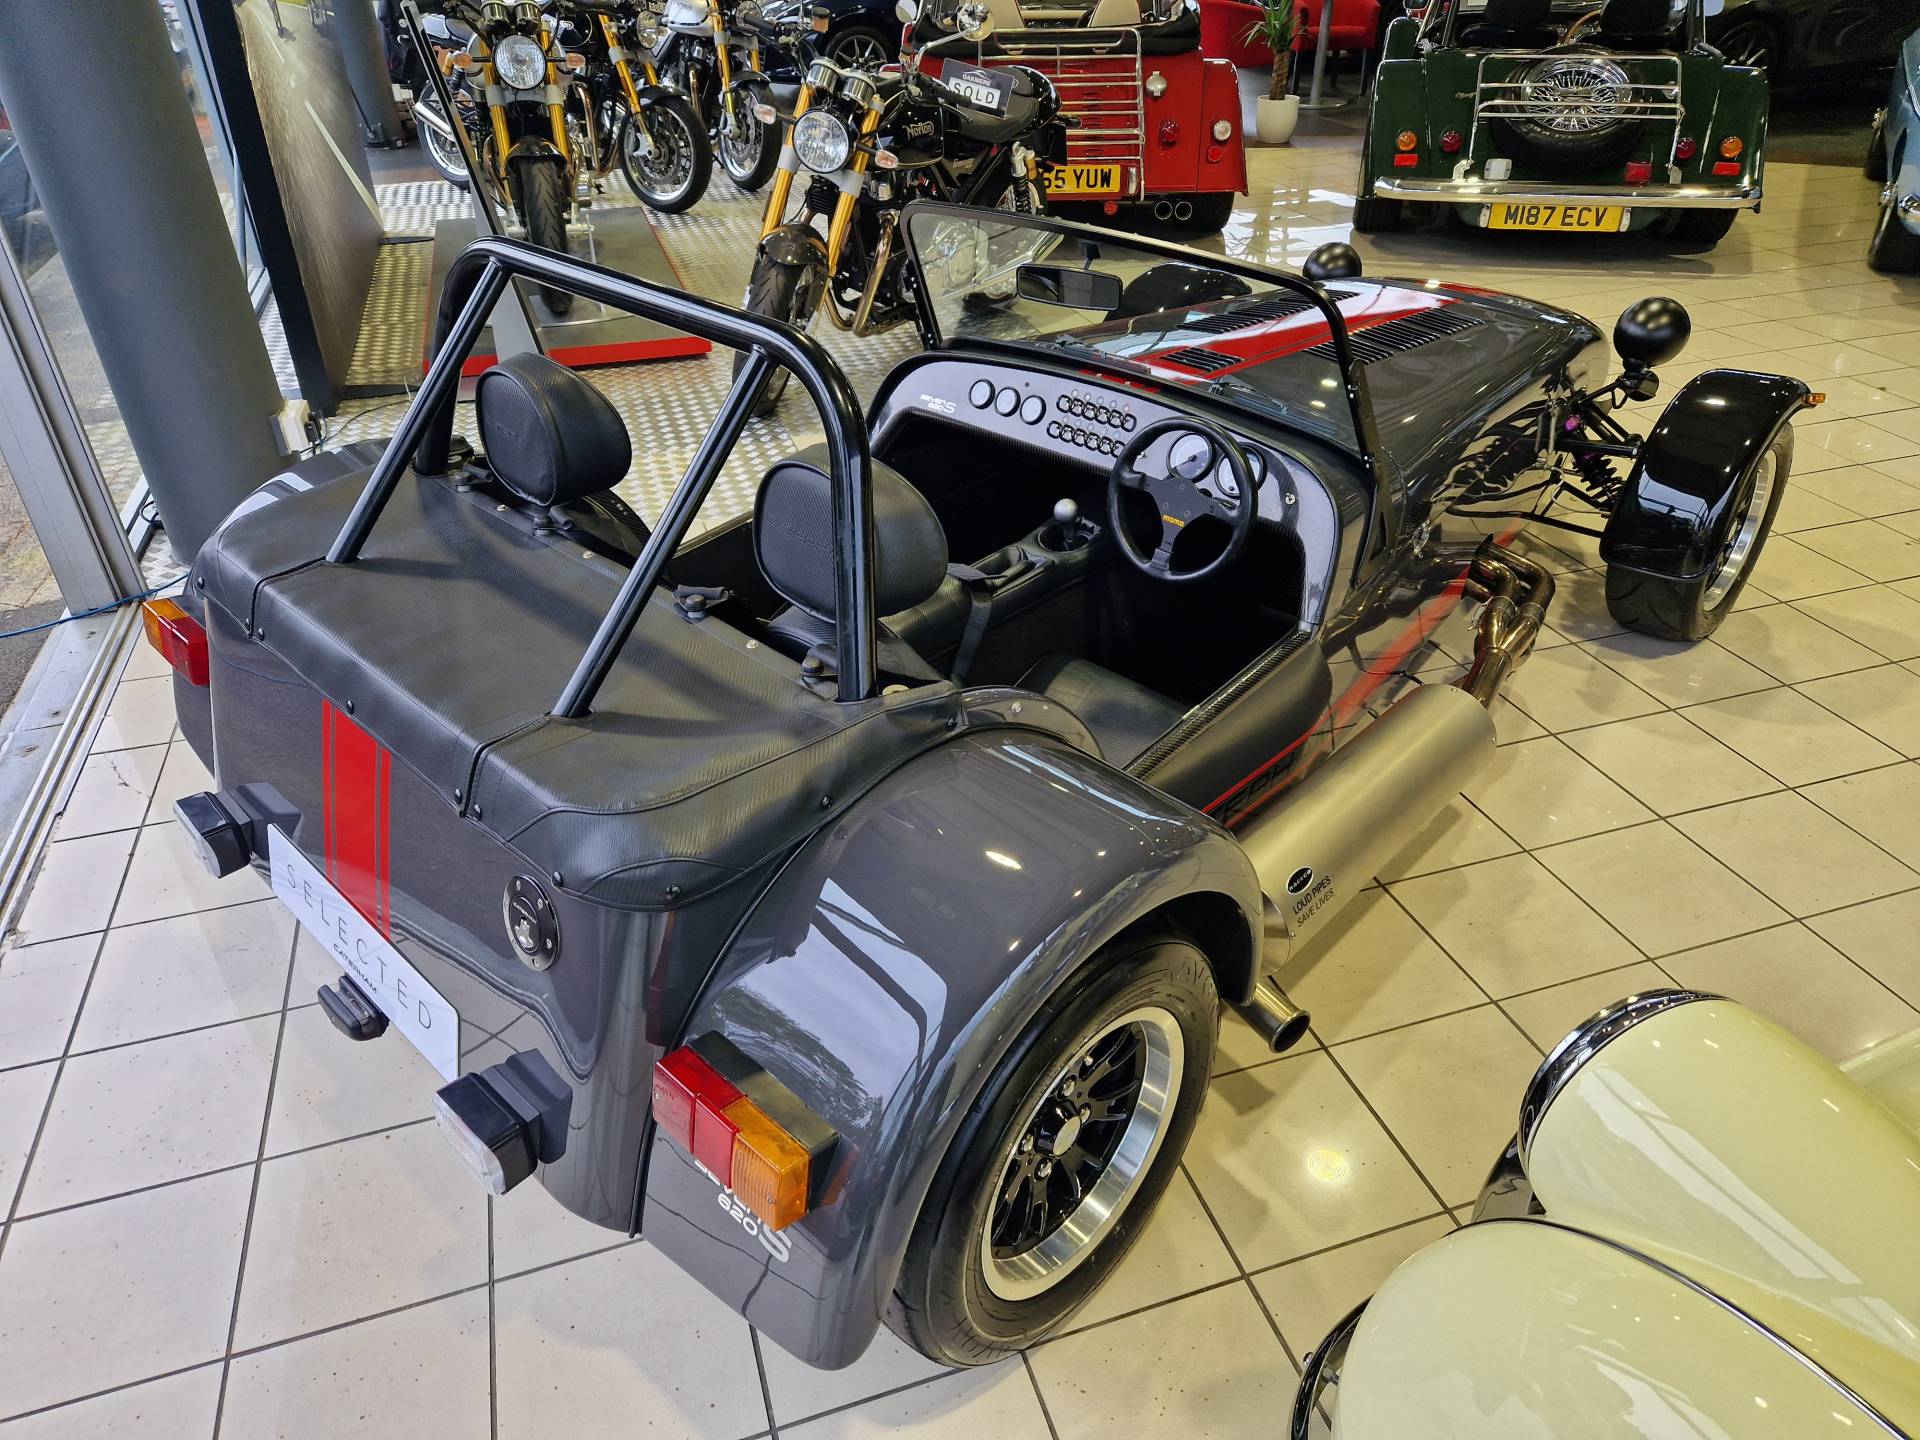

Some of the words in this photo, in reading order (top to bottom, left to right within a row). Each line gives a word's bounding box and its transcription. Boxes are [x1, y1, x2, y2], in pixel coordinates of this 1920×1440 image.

[962, 74, 992, 87] OAKMERE
[954, 82, 994, 105] SOLD
[902, 121, 935, 141] Norton
[1073, 168, 1112, 189] YUW
[1504, 205, 1556, 226] M187
[1561, 206, 1608, 227] ECV
[1162, 514, 1185, 528] momo
[1292, 892, 1313, 915] LOUD
[1311, 875, 1331, 898] PIPES
[1297, 905, 1316, 928] SAVE
[1315, 887, 1335, 912] LIVES
[287, 864, 432, 1029] SELECTED
[333, 943, 378, 994] CATERHAM
